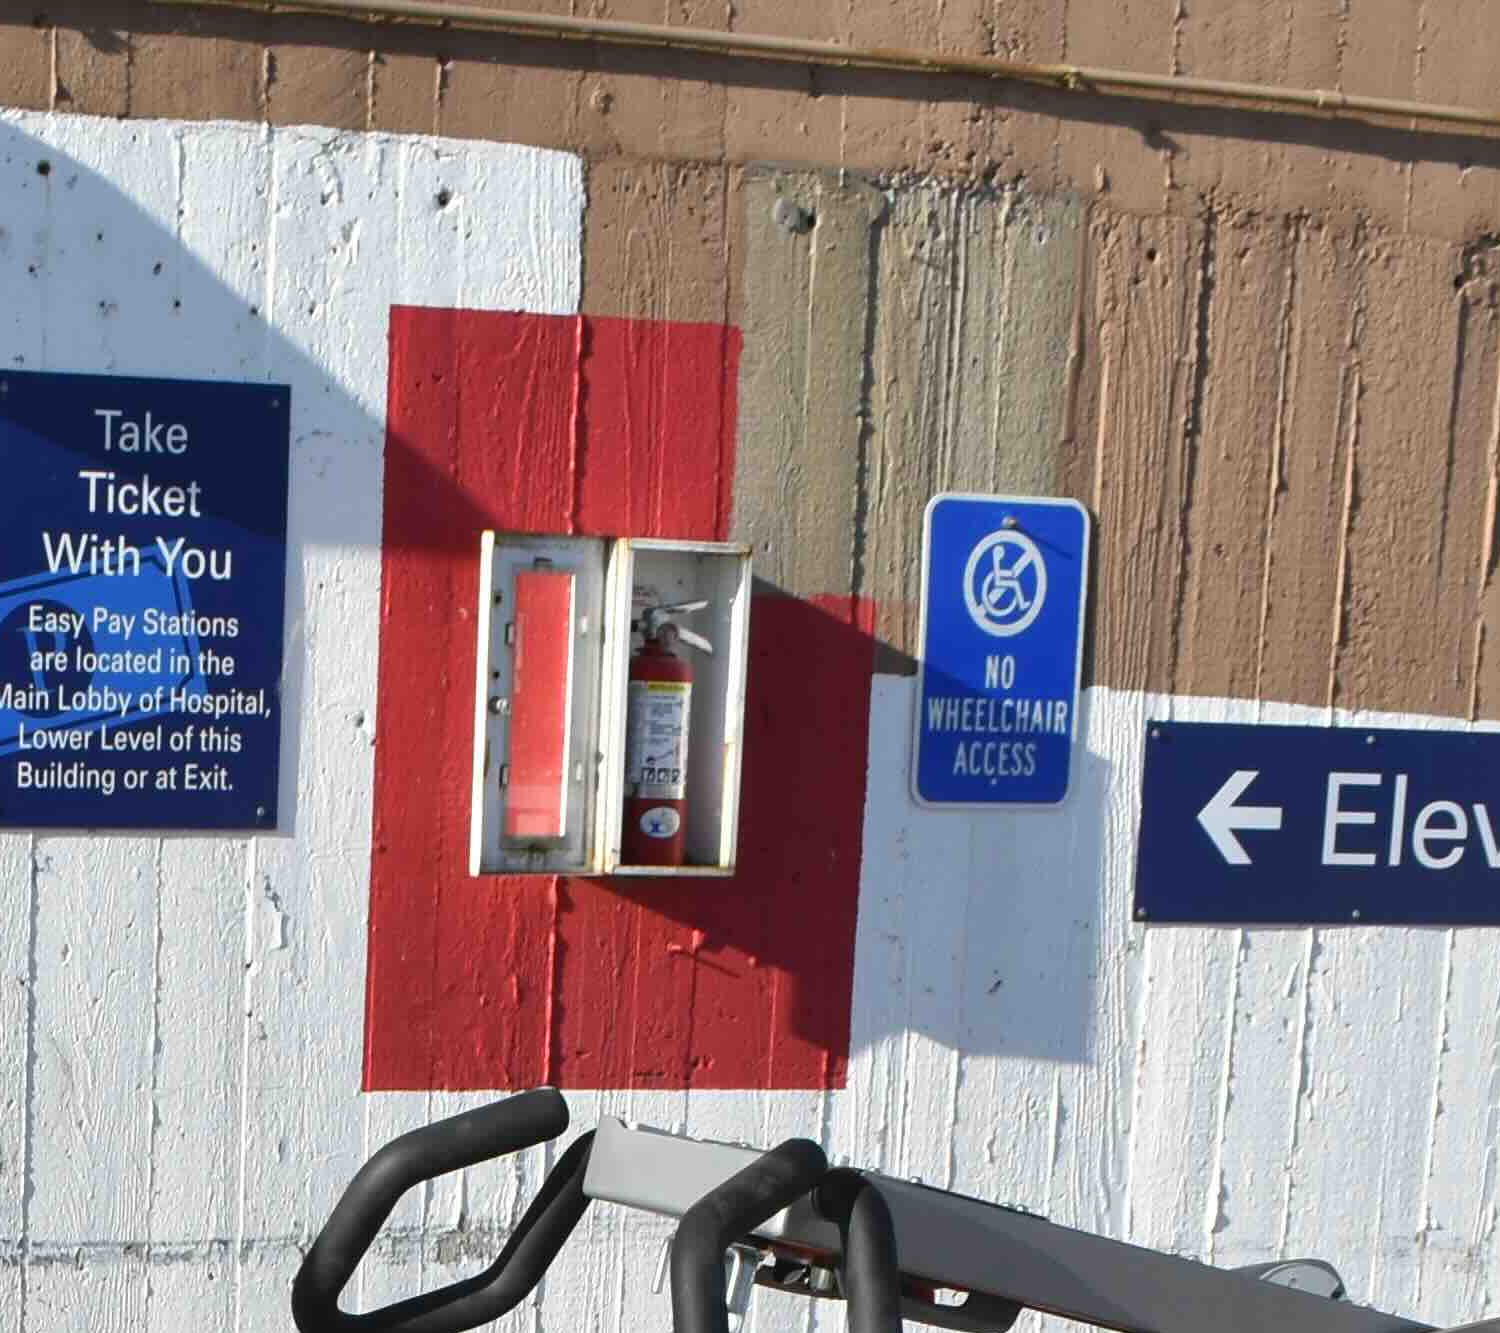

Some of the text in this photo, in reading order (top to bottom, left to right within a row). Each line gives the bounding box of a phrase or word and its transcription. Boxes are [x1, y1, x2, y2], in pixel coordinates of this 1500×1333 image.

[94, 408, 188, 454] Take
[78, 469, 201, 517] Ticket
[42, 529, 232, 580] With You
[27, 605, 239, 640] Easy Pay Stations
[30, 646, 234, 675] are located in the
[985, 655, 1015, 689] NO
[58, 684, 132, 716] Lobby
[139, 686, 164, 712] of
[170, 686, 273, 721] Hospital,
[928, 699, 1068, 734] WHEELCHAIR
[18, 722, 242, 754] Lower Level of this
[953, 742, 1036, 777] ACCESS
[16, 761, 233, 795] Building or at Exit.
